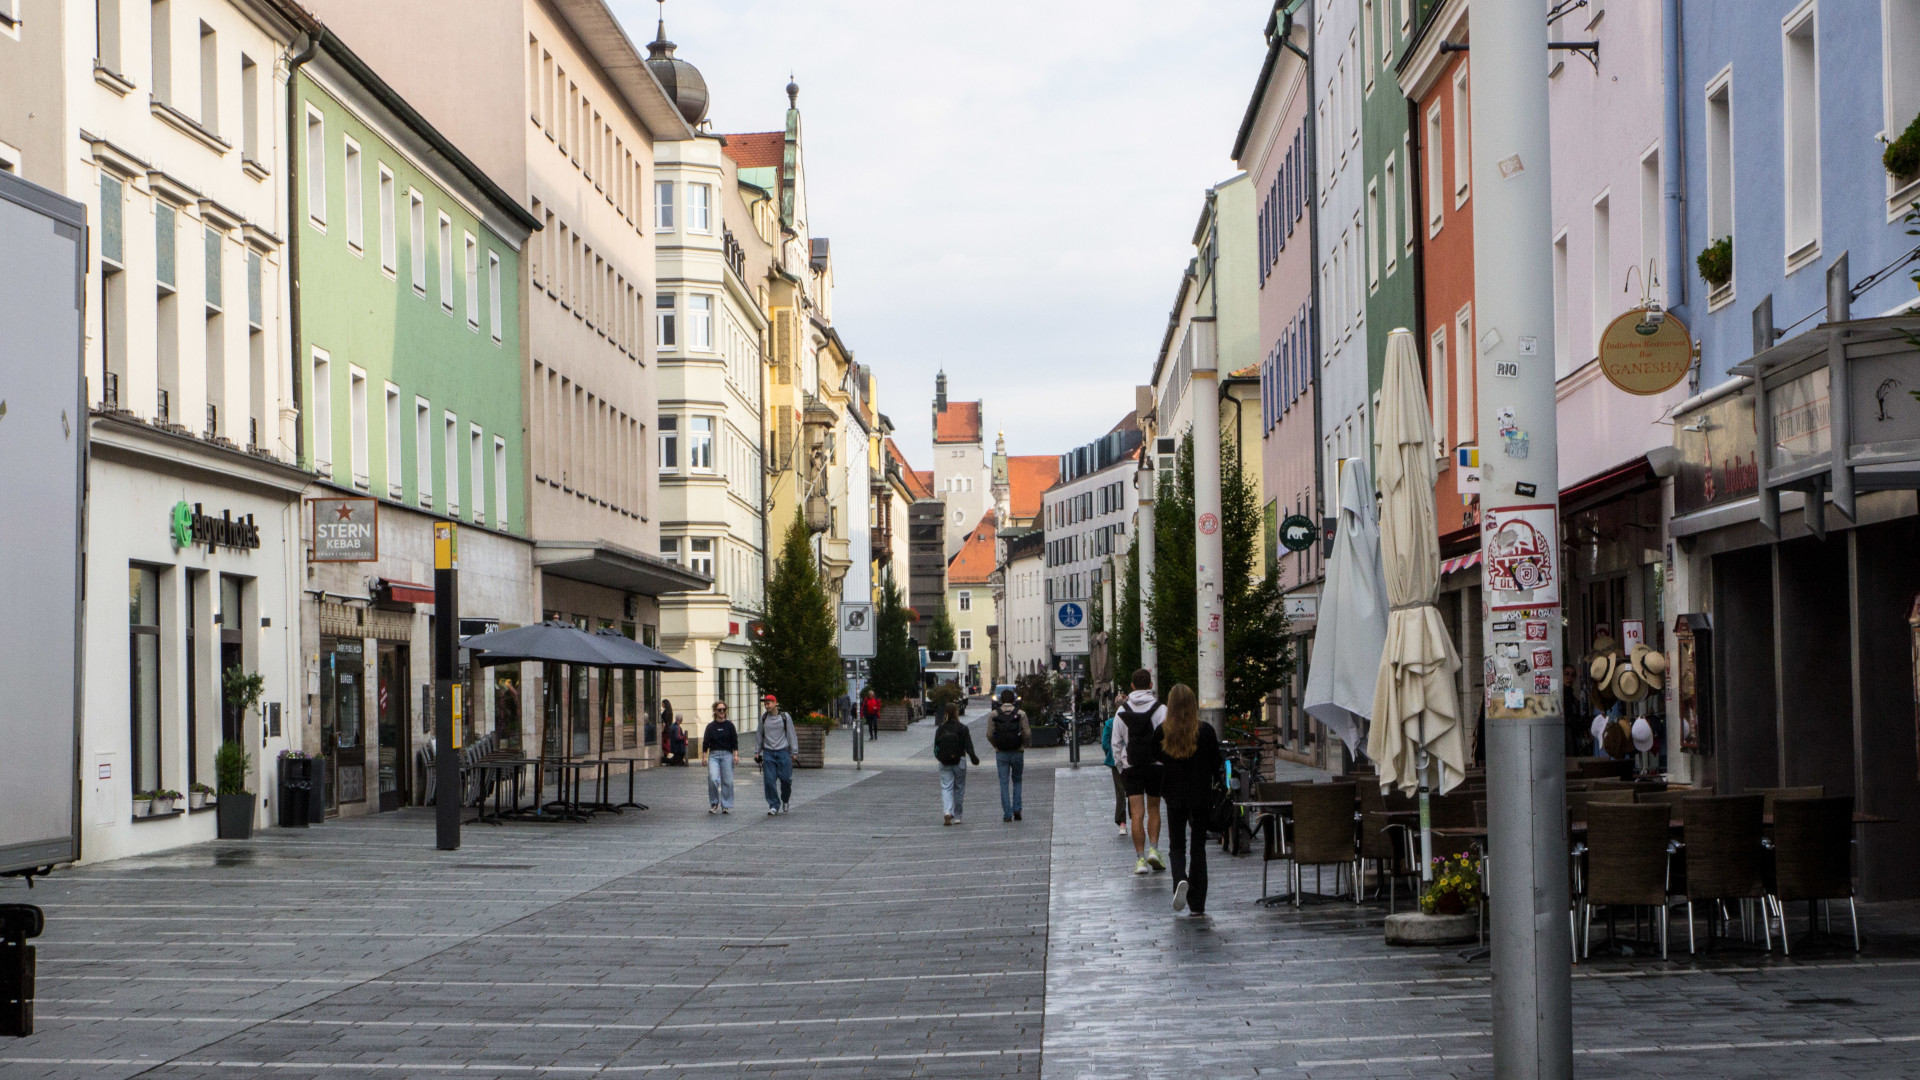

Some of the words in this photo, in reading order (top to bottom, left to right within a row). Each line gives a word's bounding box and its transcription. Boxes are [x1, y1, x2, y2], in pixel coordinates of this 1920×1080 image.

[1606, 342, 1641, 350] Indisches
[1643, 340, 1686, 349] Restaurant
[1610, 361, 1683, 376] GANESHA
[192, 503, 225, 554] elaya
[223, 509, 260, 549] hotels
[317, 523, 371, 538] STERN
[326, 539, 361, 549] KEBAB
